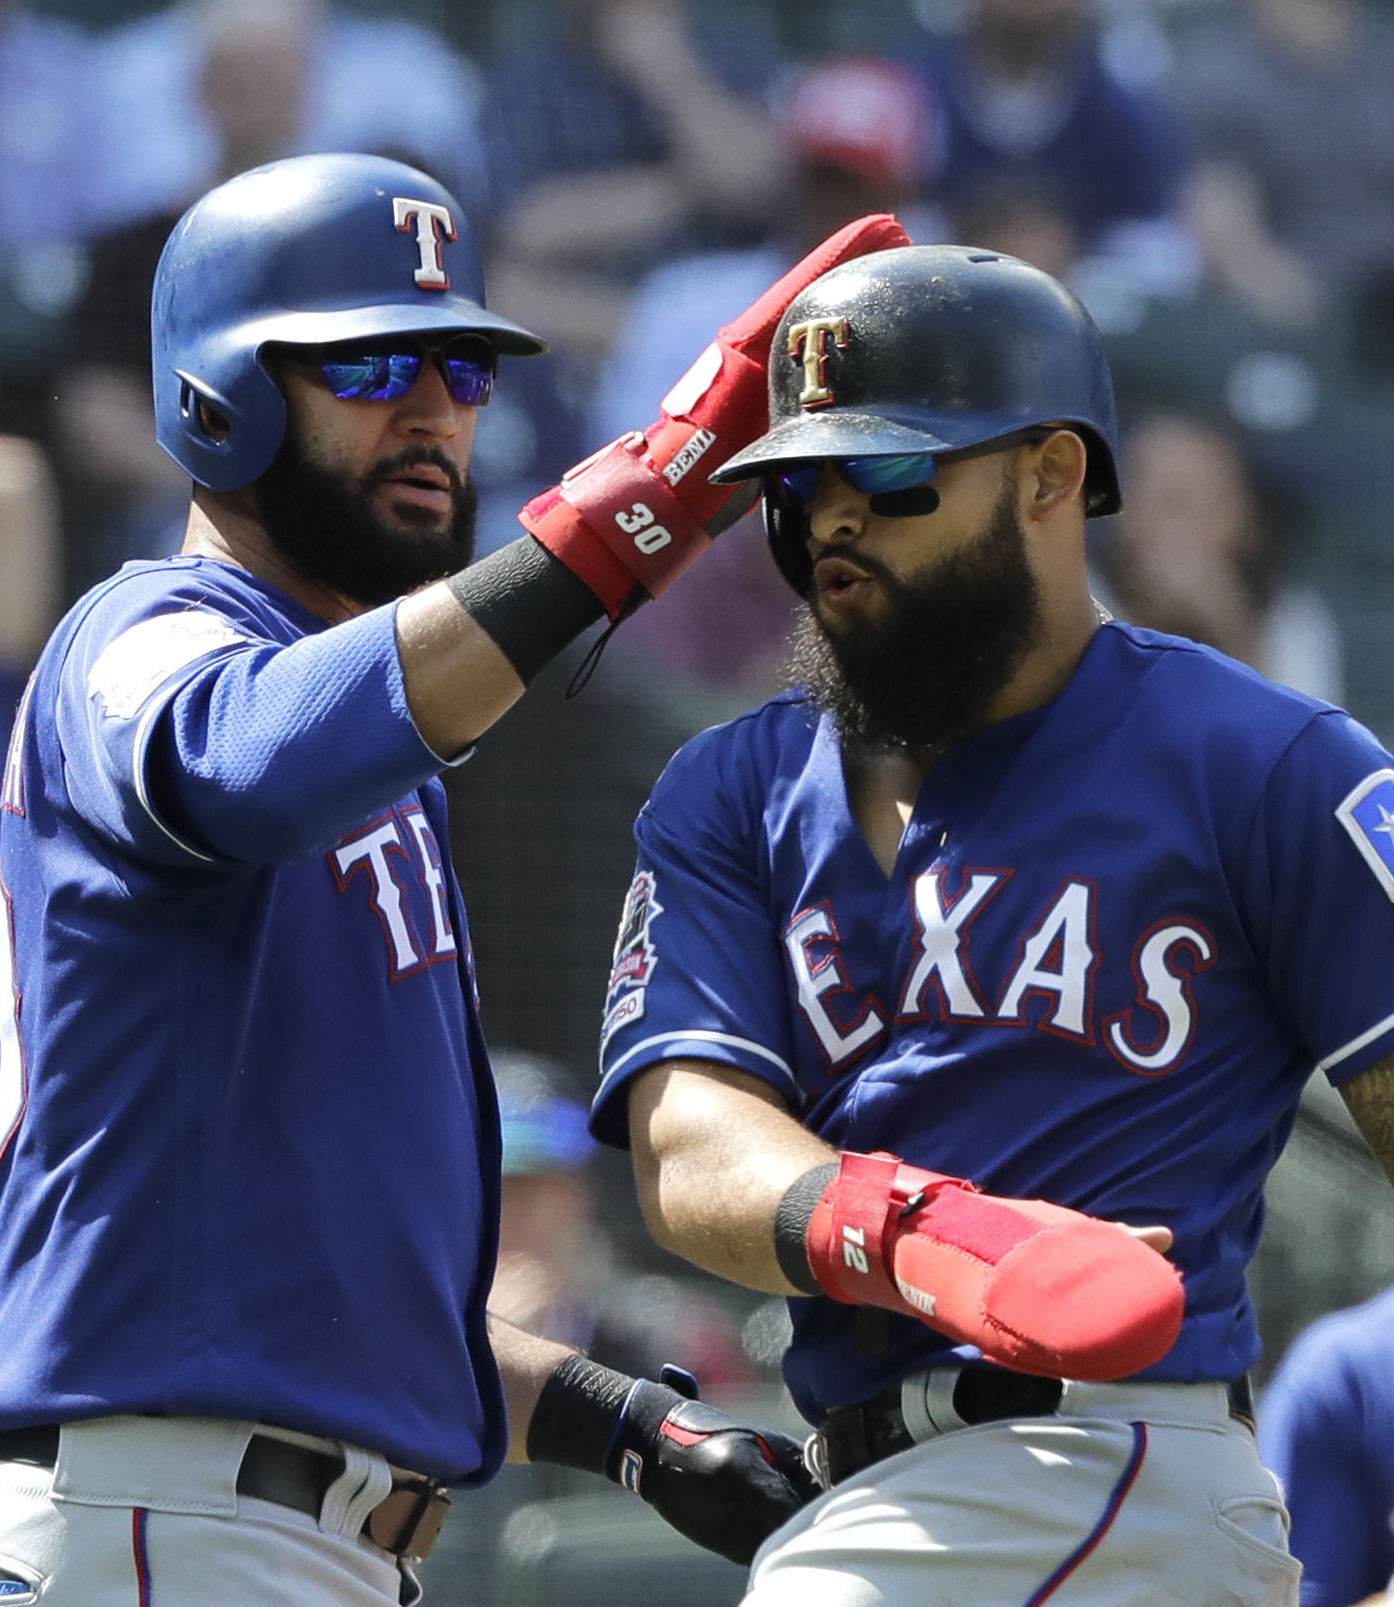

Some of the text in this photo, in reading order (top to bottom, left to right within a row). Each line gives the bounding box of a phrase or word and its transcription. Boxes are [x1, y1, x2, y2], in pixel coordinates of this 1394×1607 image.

[393, 197, 457, 290] T
[788, 316, 849, 408] T
[614, 502, 673, 555] 30
[781, 867, 1219, 1078] EXAS
[842, 1224, 869, 1274] 12
